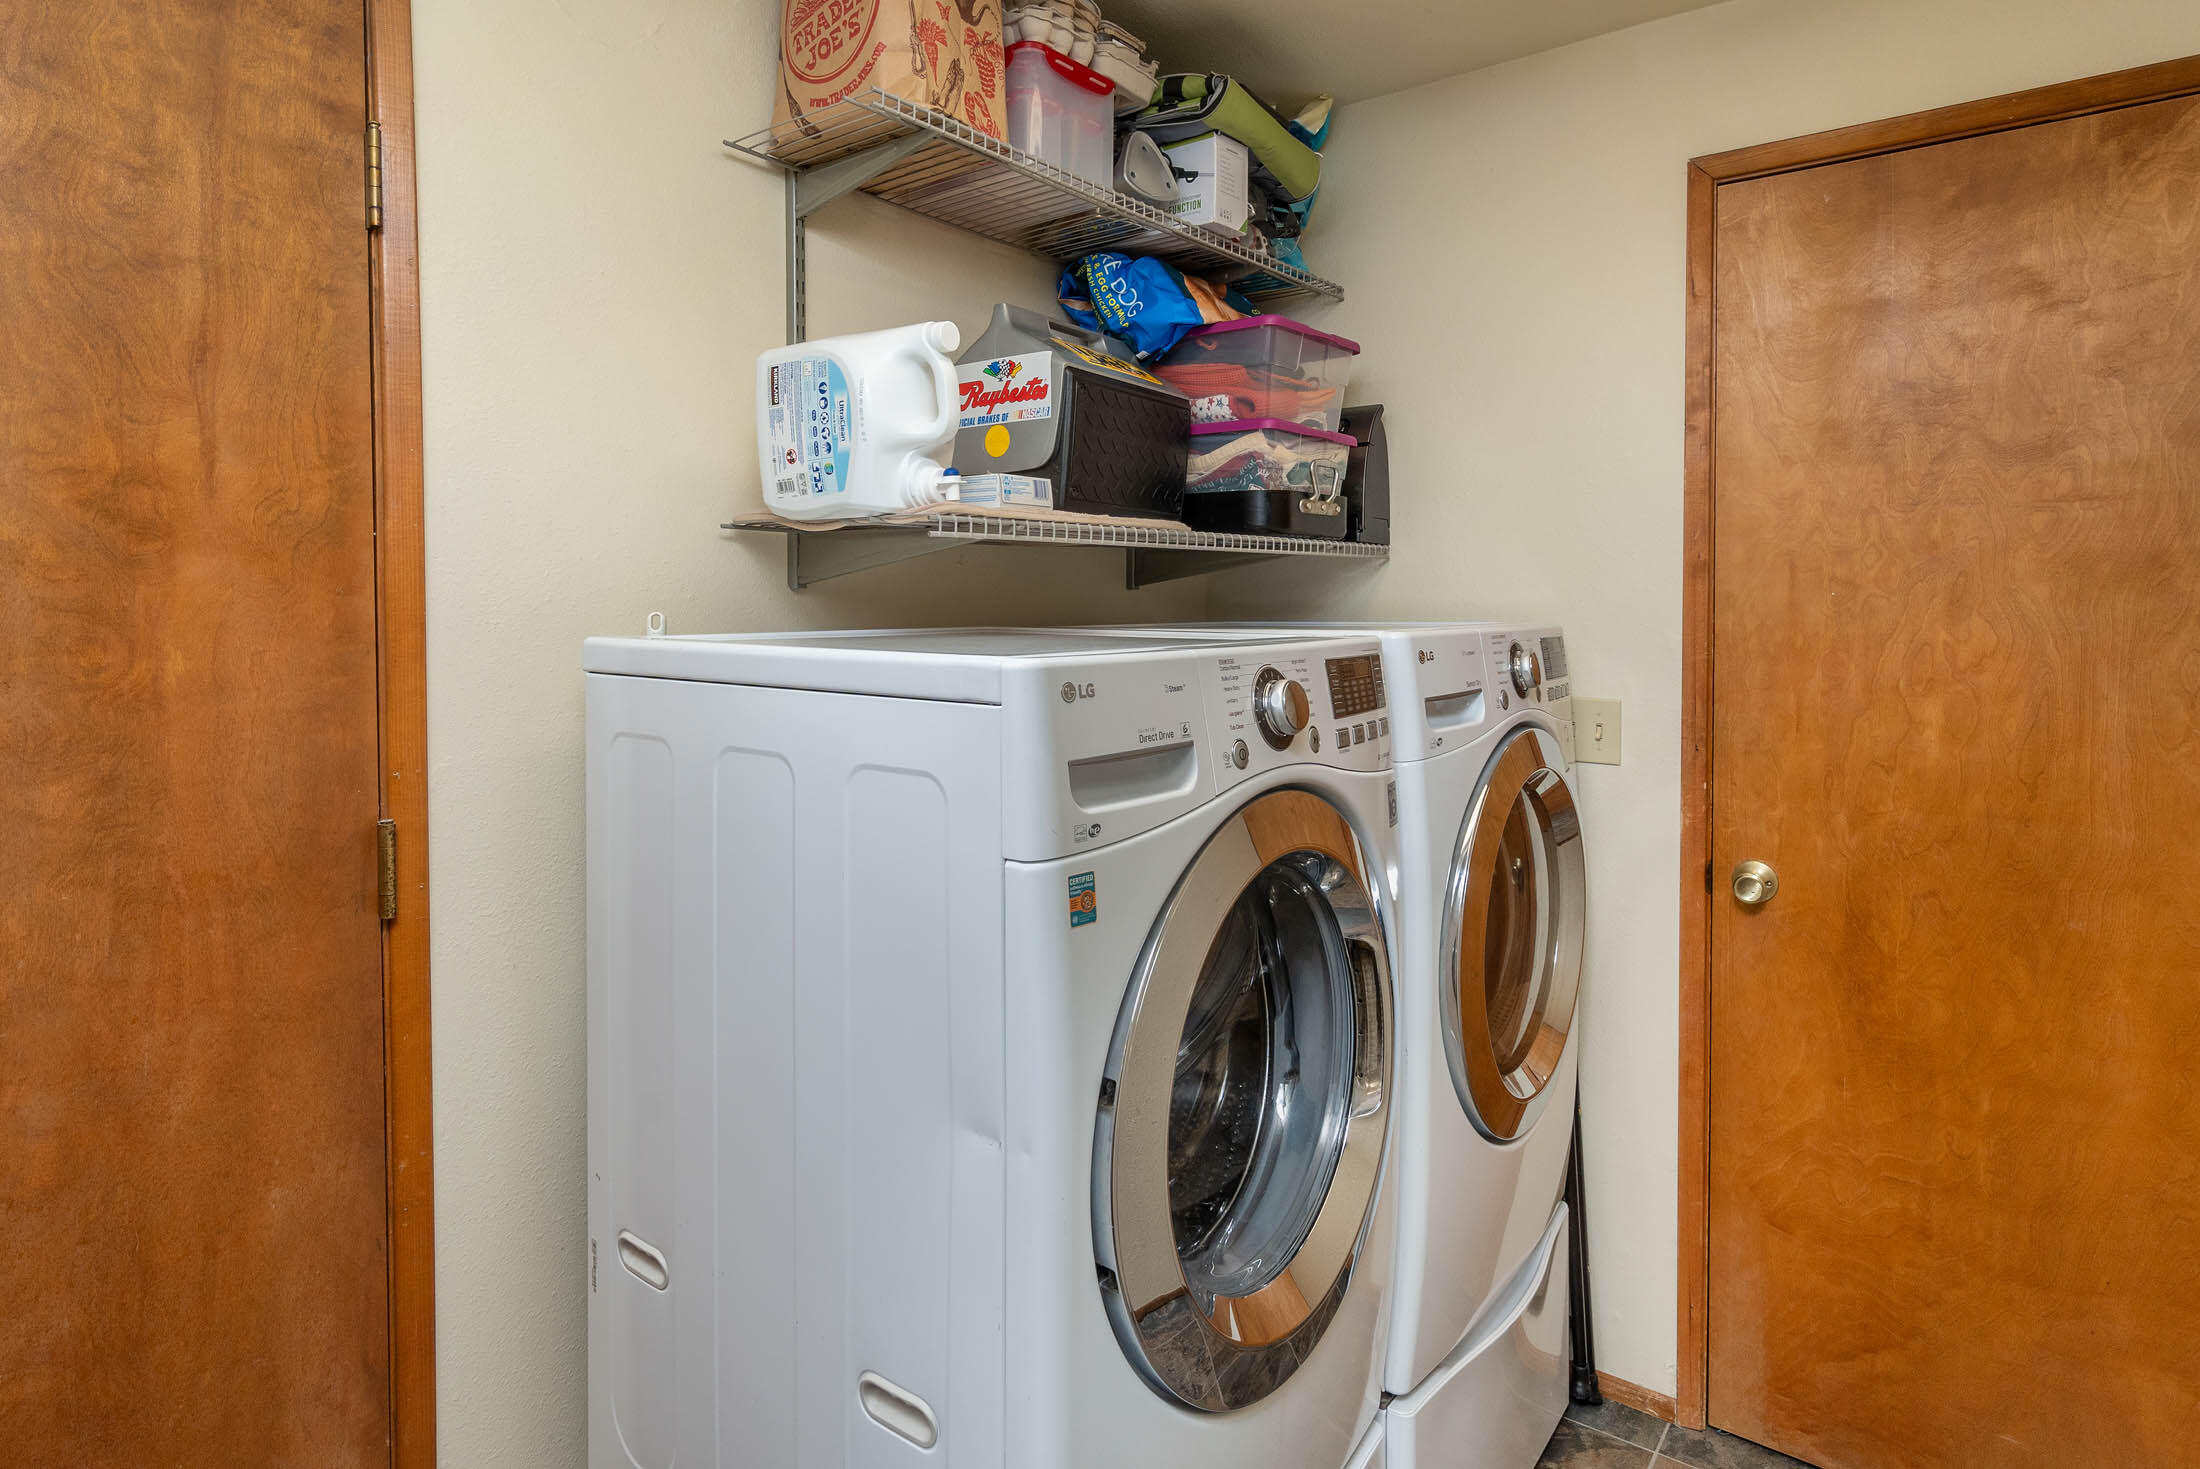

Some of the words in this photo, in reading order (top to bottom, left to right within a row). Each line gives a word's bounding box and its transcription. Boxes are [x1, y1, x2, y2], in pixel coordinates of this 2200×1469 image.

[793, 0, 863, 55] TRADE
[1168, 199, 1202, 215] FUNCTION
[1096, 271, 1109, 293] EGG
[1111, 277, 1144, 318] DOG
[772, 367, 780, 405] KIRKLAND
[959, 377, 1049, 415] Raybestos
[838, 399, 847, 442] UltraClean
[977, 413, 1001, 425] BRAKES
[1001, 412, 1009, 422] OF
[1139, 733, 1158, 744] Direct
[1159, 730, 1175, 740] Drive
